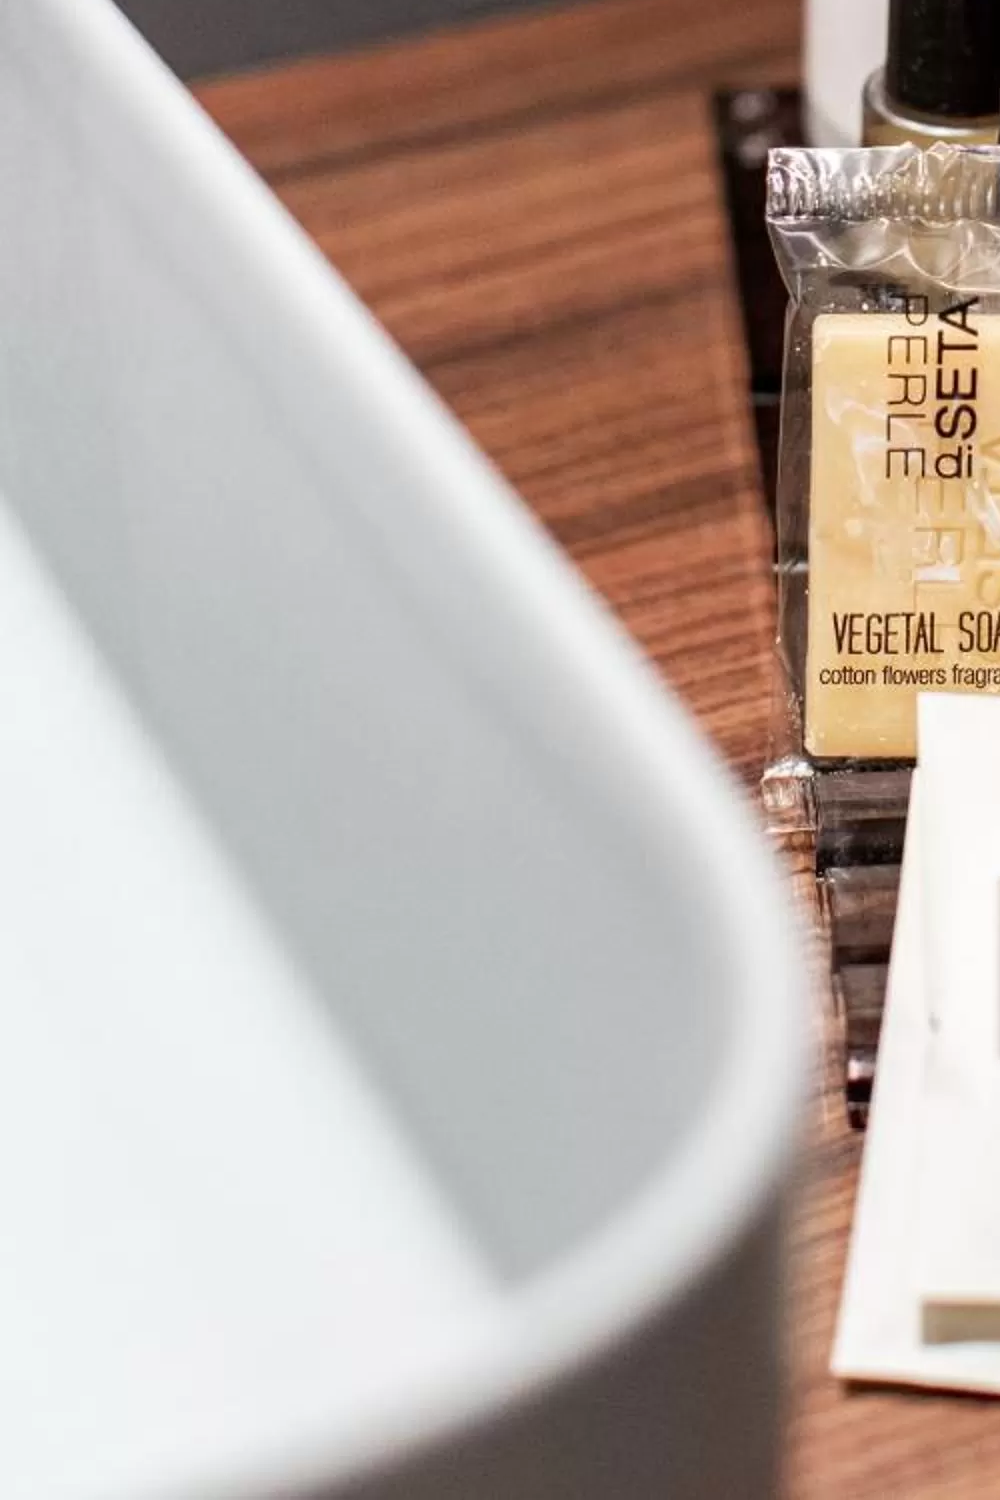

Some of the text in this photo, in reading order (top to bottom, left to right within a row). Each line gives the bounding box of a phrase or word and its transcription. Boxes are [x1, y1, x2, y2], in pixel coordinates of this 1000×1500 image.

[886, 295, 928, 479] PERLE
[935, 297, 979, 440] SETA
[819, 665, 876, 685] cotton
[882, 665, 947, 685] flowers
[832, 611, 944, 655] VEGETAL
